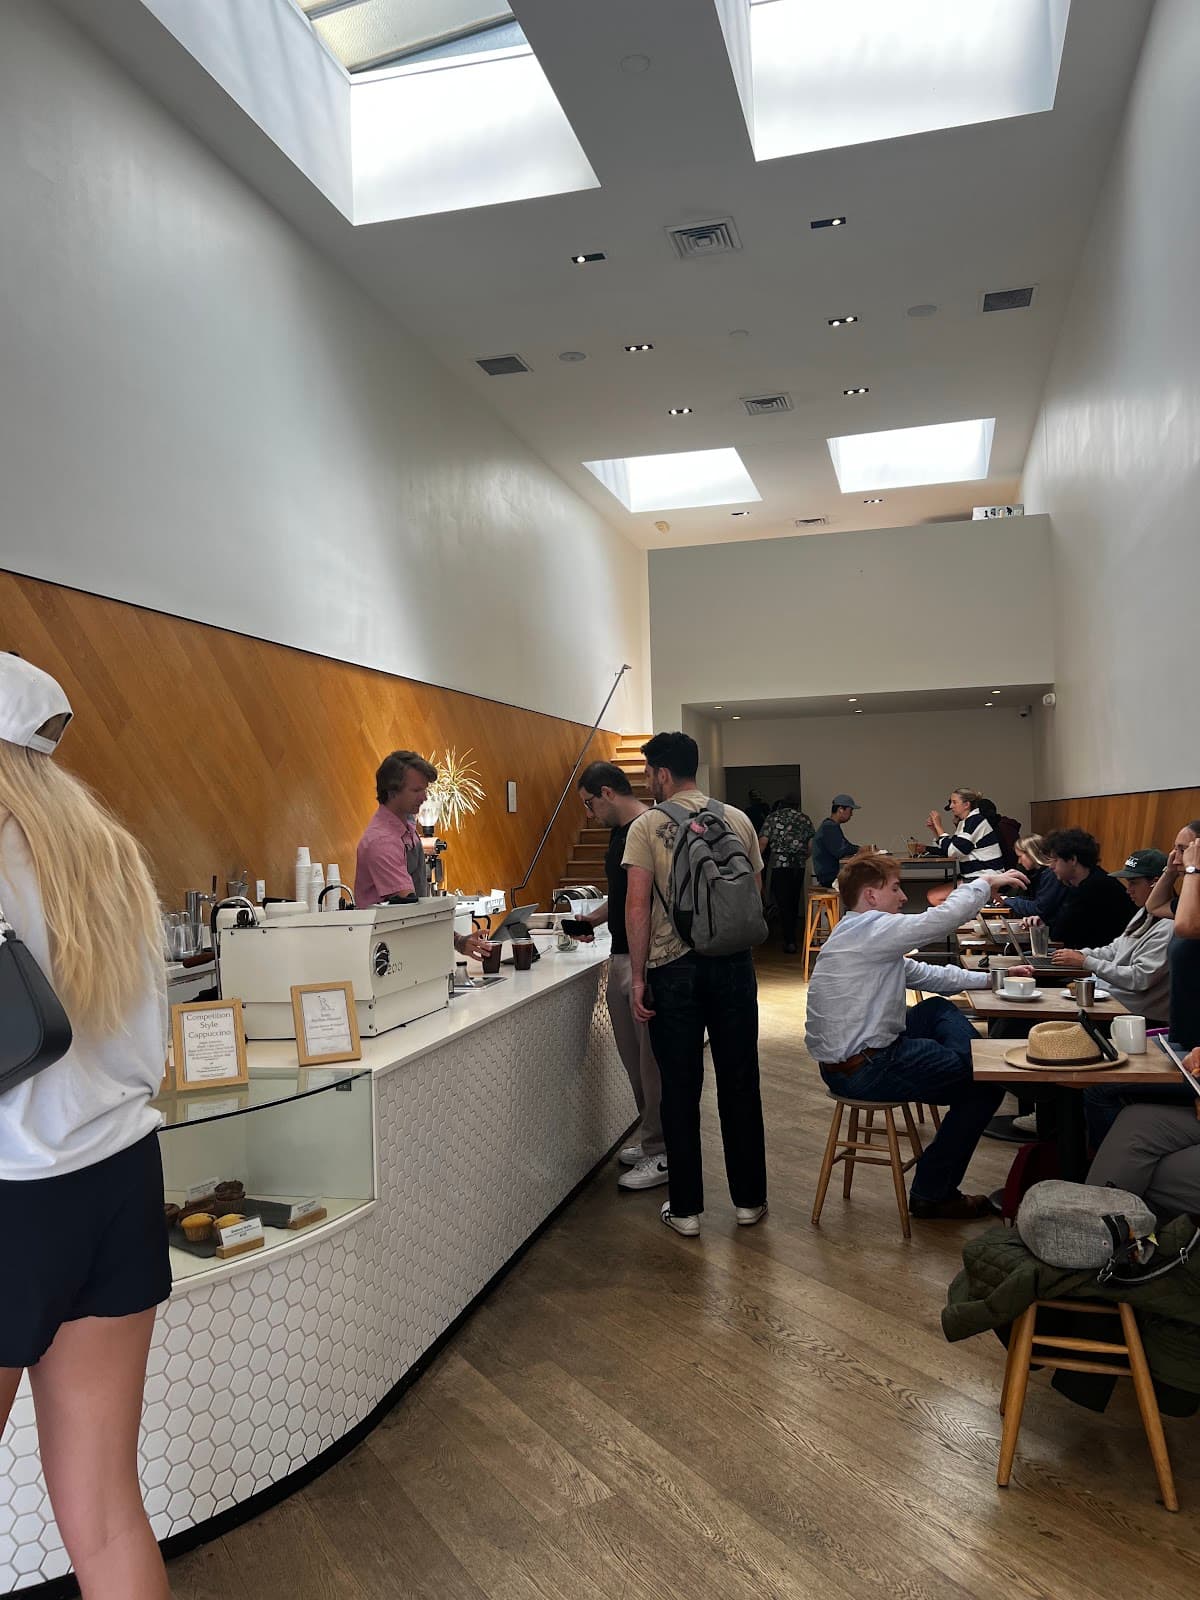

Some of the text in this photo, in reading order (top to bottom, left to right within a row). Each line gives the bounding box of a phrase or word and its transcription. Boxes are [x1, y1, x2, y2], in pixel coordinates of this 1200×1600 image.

[186, 1012, 231, 1021] Competition
[200, 1021, 218, 1029] Style
[188, 1030, 231, 1039] Cappuccino
